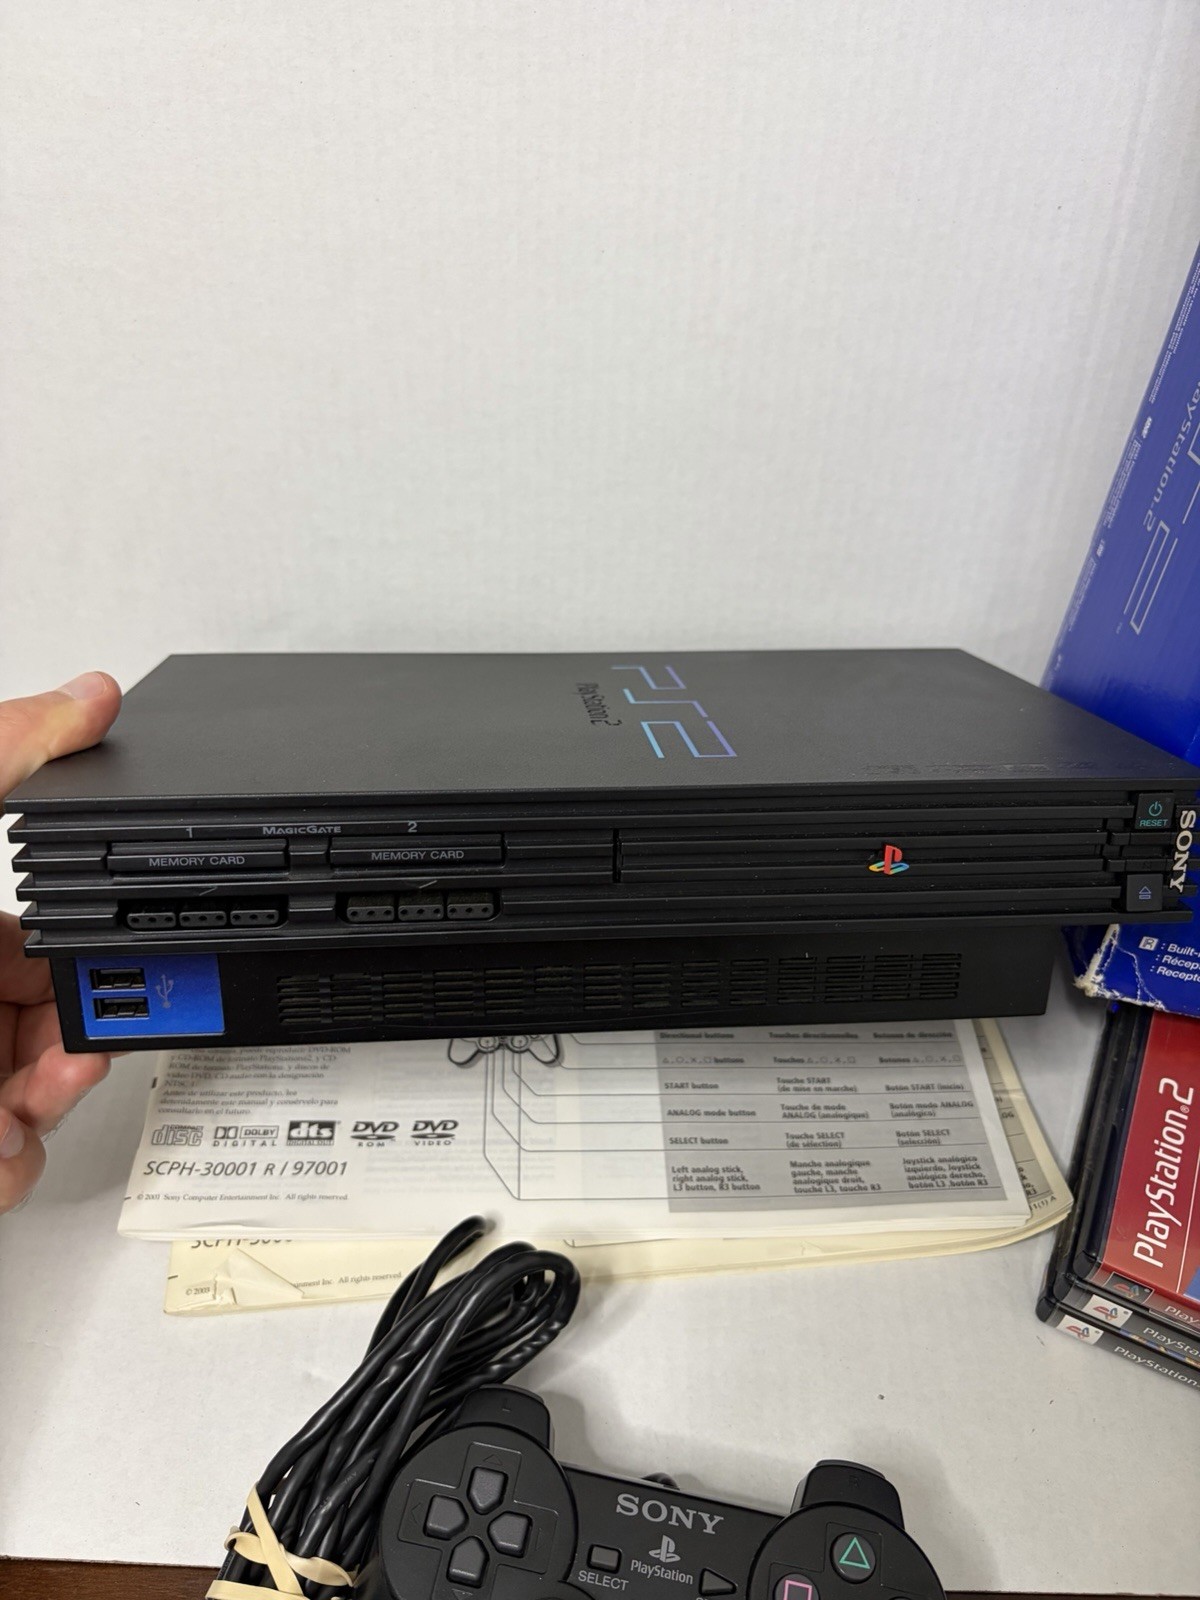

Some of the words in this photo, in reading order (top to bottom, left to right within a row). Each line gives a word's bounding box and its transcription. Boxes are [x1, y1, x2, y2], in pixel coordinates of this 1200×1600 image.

[407, 821, 418, 833] 2
[1139, 819, 1169, 827] RESET
[185, 826, 194, 838] 1
[370, 850, 428, 861] MEMORY
[430, 849, 465, 860] CARD
[1170, 810, 1197, 894] SONY
[148, 856, 205, 868] MEMORY
[209, 855, 246, 866] CARD
[1161, 954, 1200, 971] Récep
[1156, 965, 1200, 983] Recepto
[940, 1101, 974, 1109] ANALOG
[667, 1109, 702, 1117] ANALOG
[728, 1109, 757, 1117] button
[289, 1121, 334, 1138] dts
[353, 1121, 400, 1133] DVD
[412, 1120, 459, 1132] DVD
[785, 1132, 815, 1140] Touche
[816, 1131, 845, 1139] SELECT
[922, 1129, 951, 1137] SELECT
[668, 1137, 698, 1145] SELECT
[143, 1161, 258, 1176] SCPH-30001
[263, 1163, 276, 1176] R
[292, 1161, 349, 1176] 97001
[691, 1166, 719, 1175] analog
[721, 1165, 744, 1174] stick,
[789, 1160, 822, 1168] Manche
[825, 1159, 871, 1169] analogique
[825, 1168, 858, 1176] manche
[672, 1174, 694, 1183] right
[696, 1174, 724, 1183] analog
[726, 1174, 748, 1183] stick,
[976, 1179, 989, 1187] R3
[673, 1183, 683, 1191] L3
[718, 1183, 729, 1191] R3
[731, 1183, 761, 1191] button
[794, 1186, 823, 1194] touche
[839, 1184, 869, 1192] touche
[870, 1183, 882, 1191] R3
[163, 1193, 181, 1202] Sony
[183, 1193, 218, 1202] Computer
[349, 1274, 371, 1284] rights
[1165, 1305, 1200, 1324] Play
[1143, 1327, 1200, 1358] PlaySta
[615, 1493, 724, 1536] SONY
[630, 1559, 694, 1585] PlayStation
[578, 1570, 630, 1591] SELECT
